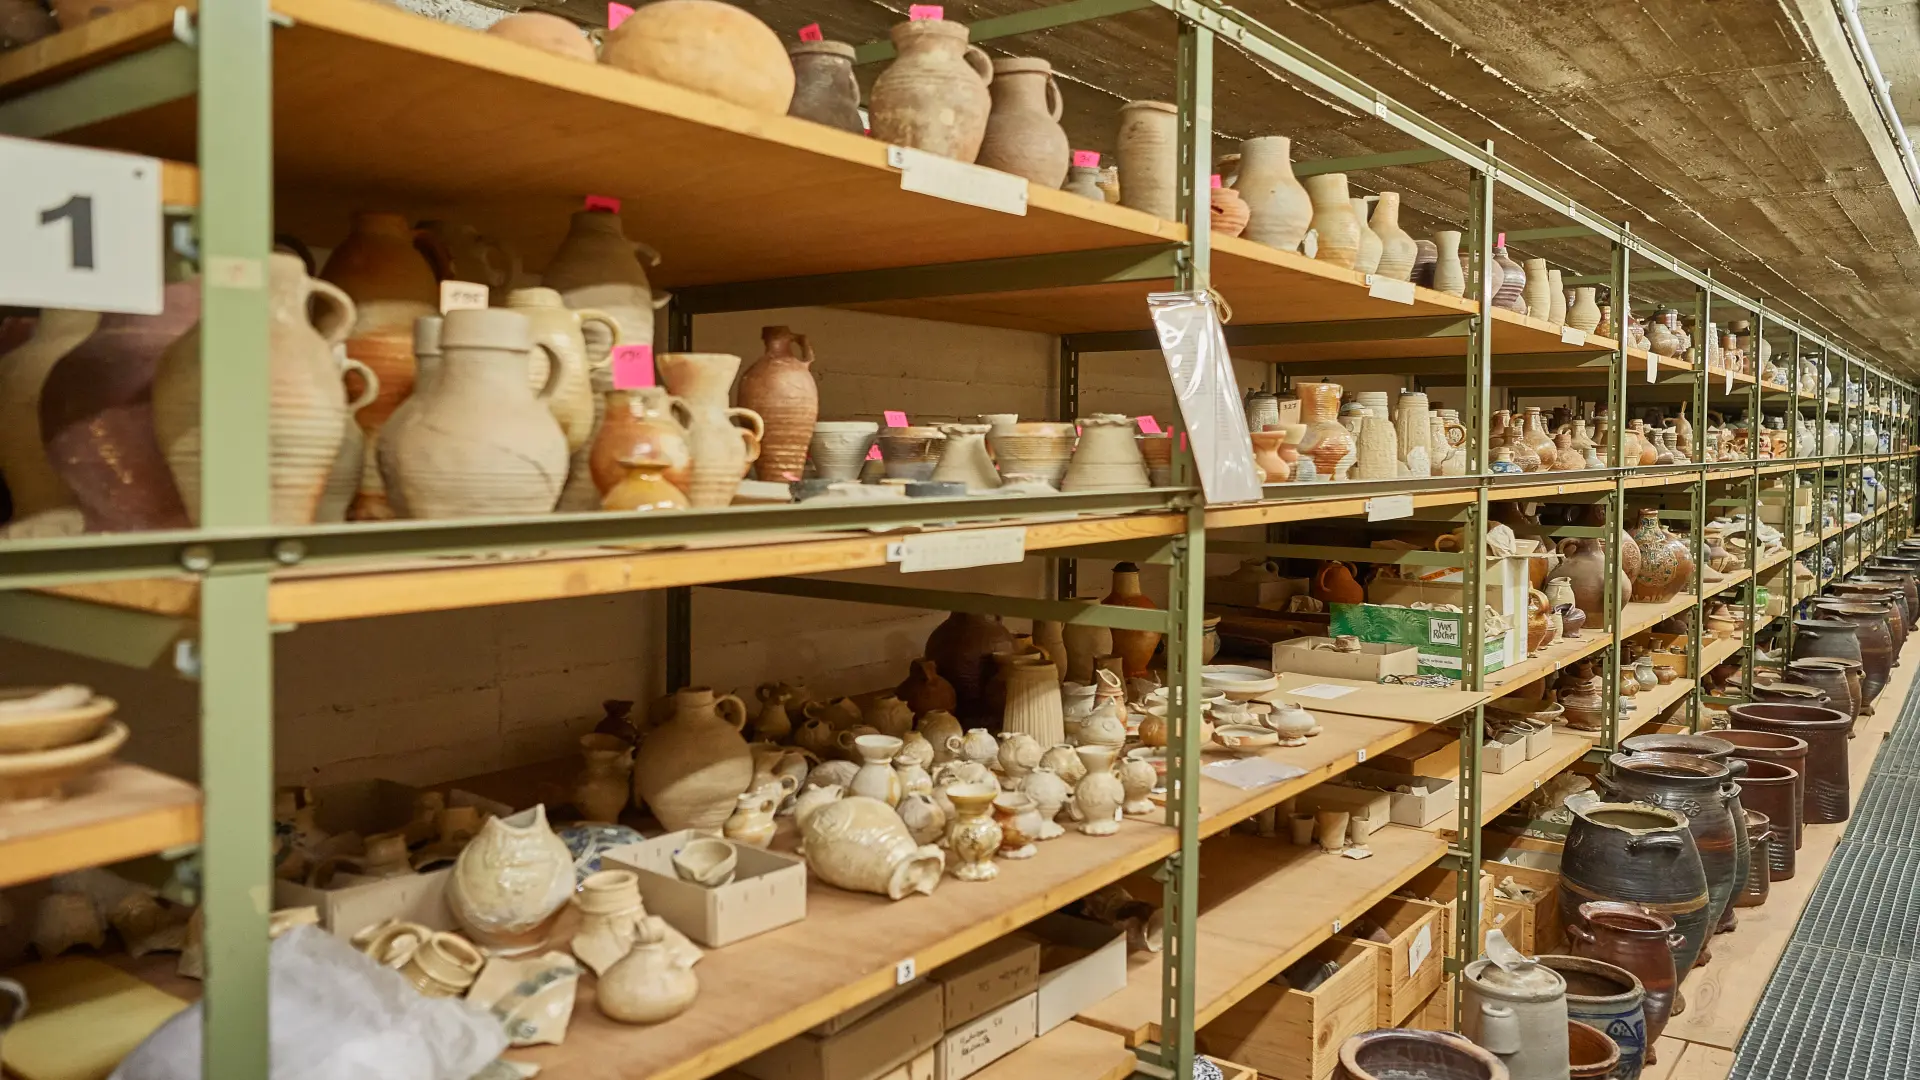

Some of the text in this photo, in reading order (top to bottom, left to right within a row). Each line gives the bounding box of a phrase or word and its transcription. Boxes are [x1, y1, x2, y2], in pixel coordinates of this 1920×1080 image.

[41, 196, 93, 268] 1
[1437, 622, 1452, 633] Yves
[1433, 629, 1457, 640] Rocher
